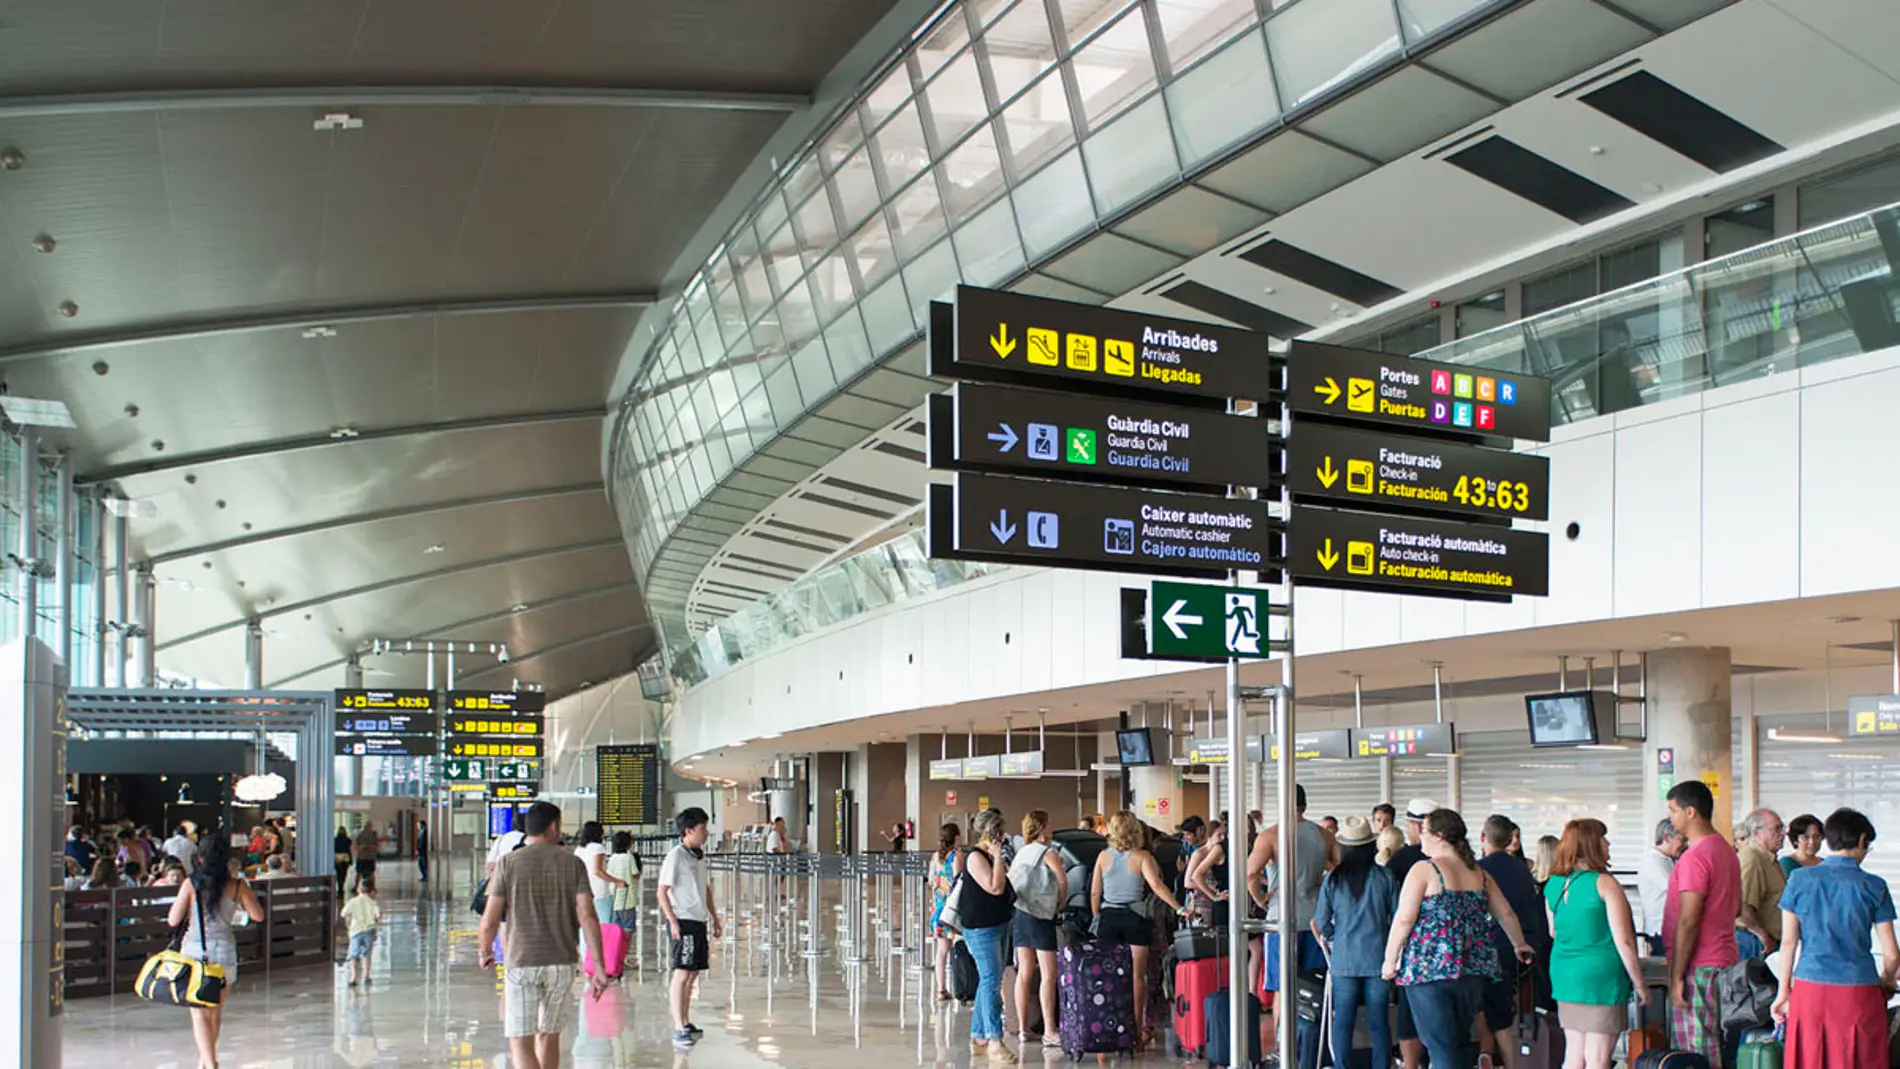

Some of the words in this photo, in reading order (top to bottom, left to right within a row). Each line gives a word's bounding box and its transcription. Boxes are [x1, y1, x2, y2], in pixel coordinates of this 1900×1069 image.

[1142, 326, 1218, 353] Arribades
[1141, 346, 1181, 364] Arrivals
[1141, 362, 1202, 385] Llegadas
[1380, 366, 1420, 386] Portes
[1380, 384, 1408, 399] Gates
[1435, 375, 1446, 391] A
[1480, 381, 1491, 398] C
[1502, 383, 1513, 400] R
[1380, 398, 1426, 419] Puertas
[1435, 402, 1446, 419] D
[1460, 406, 1469, 422] E
[1480, 409, 1490, 425] F
[1107, 414, 1160, 436] Guàrdia
[1161, 421, 1189, 438] Civil
[1107, 433, 1145, 450] Guardia
[1147, 437, 1168, 452] Civil
[1107, 449, 1160, 470] Guardia
[1161, 455, 1189, 472] Civil
[1379, 448, 1442, 469] Facturació
[1379, 465, 1418, 481] Check-in
[1379, 480, 1448, 502] Facturación
[1453, 475, 1486, 506] 43
[1486, 480, 1497, 492] to
[1496, 480, 1529, 512] 63
[1487, 497, 1496, 508] a
[1141, 504, 1185, 522] Caixer
[1188, 511, 1252, 529] automàtic
[1141, 523, 1193, 540] Automatic
[1194, 530, 1231, 543] cashier
[1379, 528, 1442, 549] Facturació
[1443, 537, 1507, 554] automàtica
[1141, 539, 1186, 559] Cajero
[1188, 545, 1261, 563] automático
[1380, 546, 1402, 560] Auto
[1402, 548, 1440, 563] check-in
[1379, 561, 1448, 581] Facturación
[1450, 568, 1513, 586] automática
